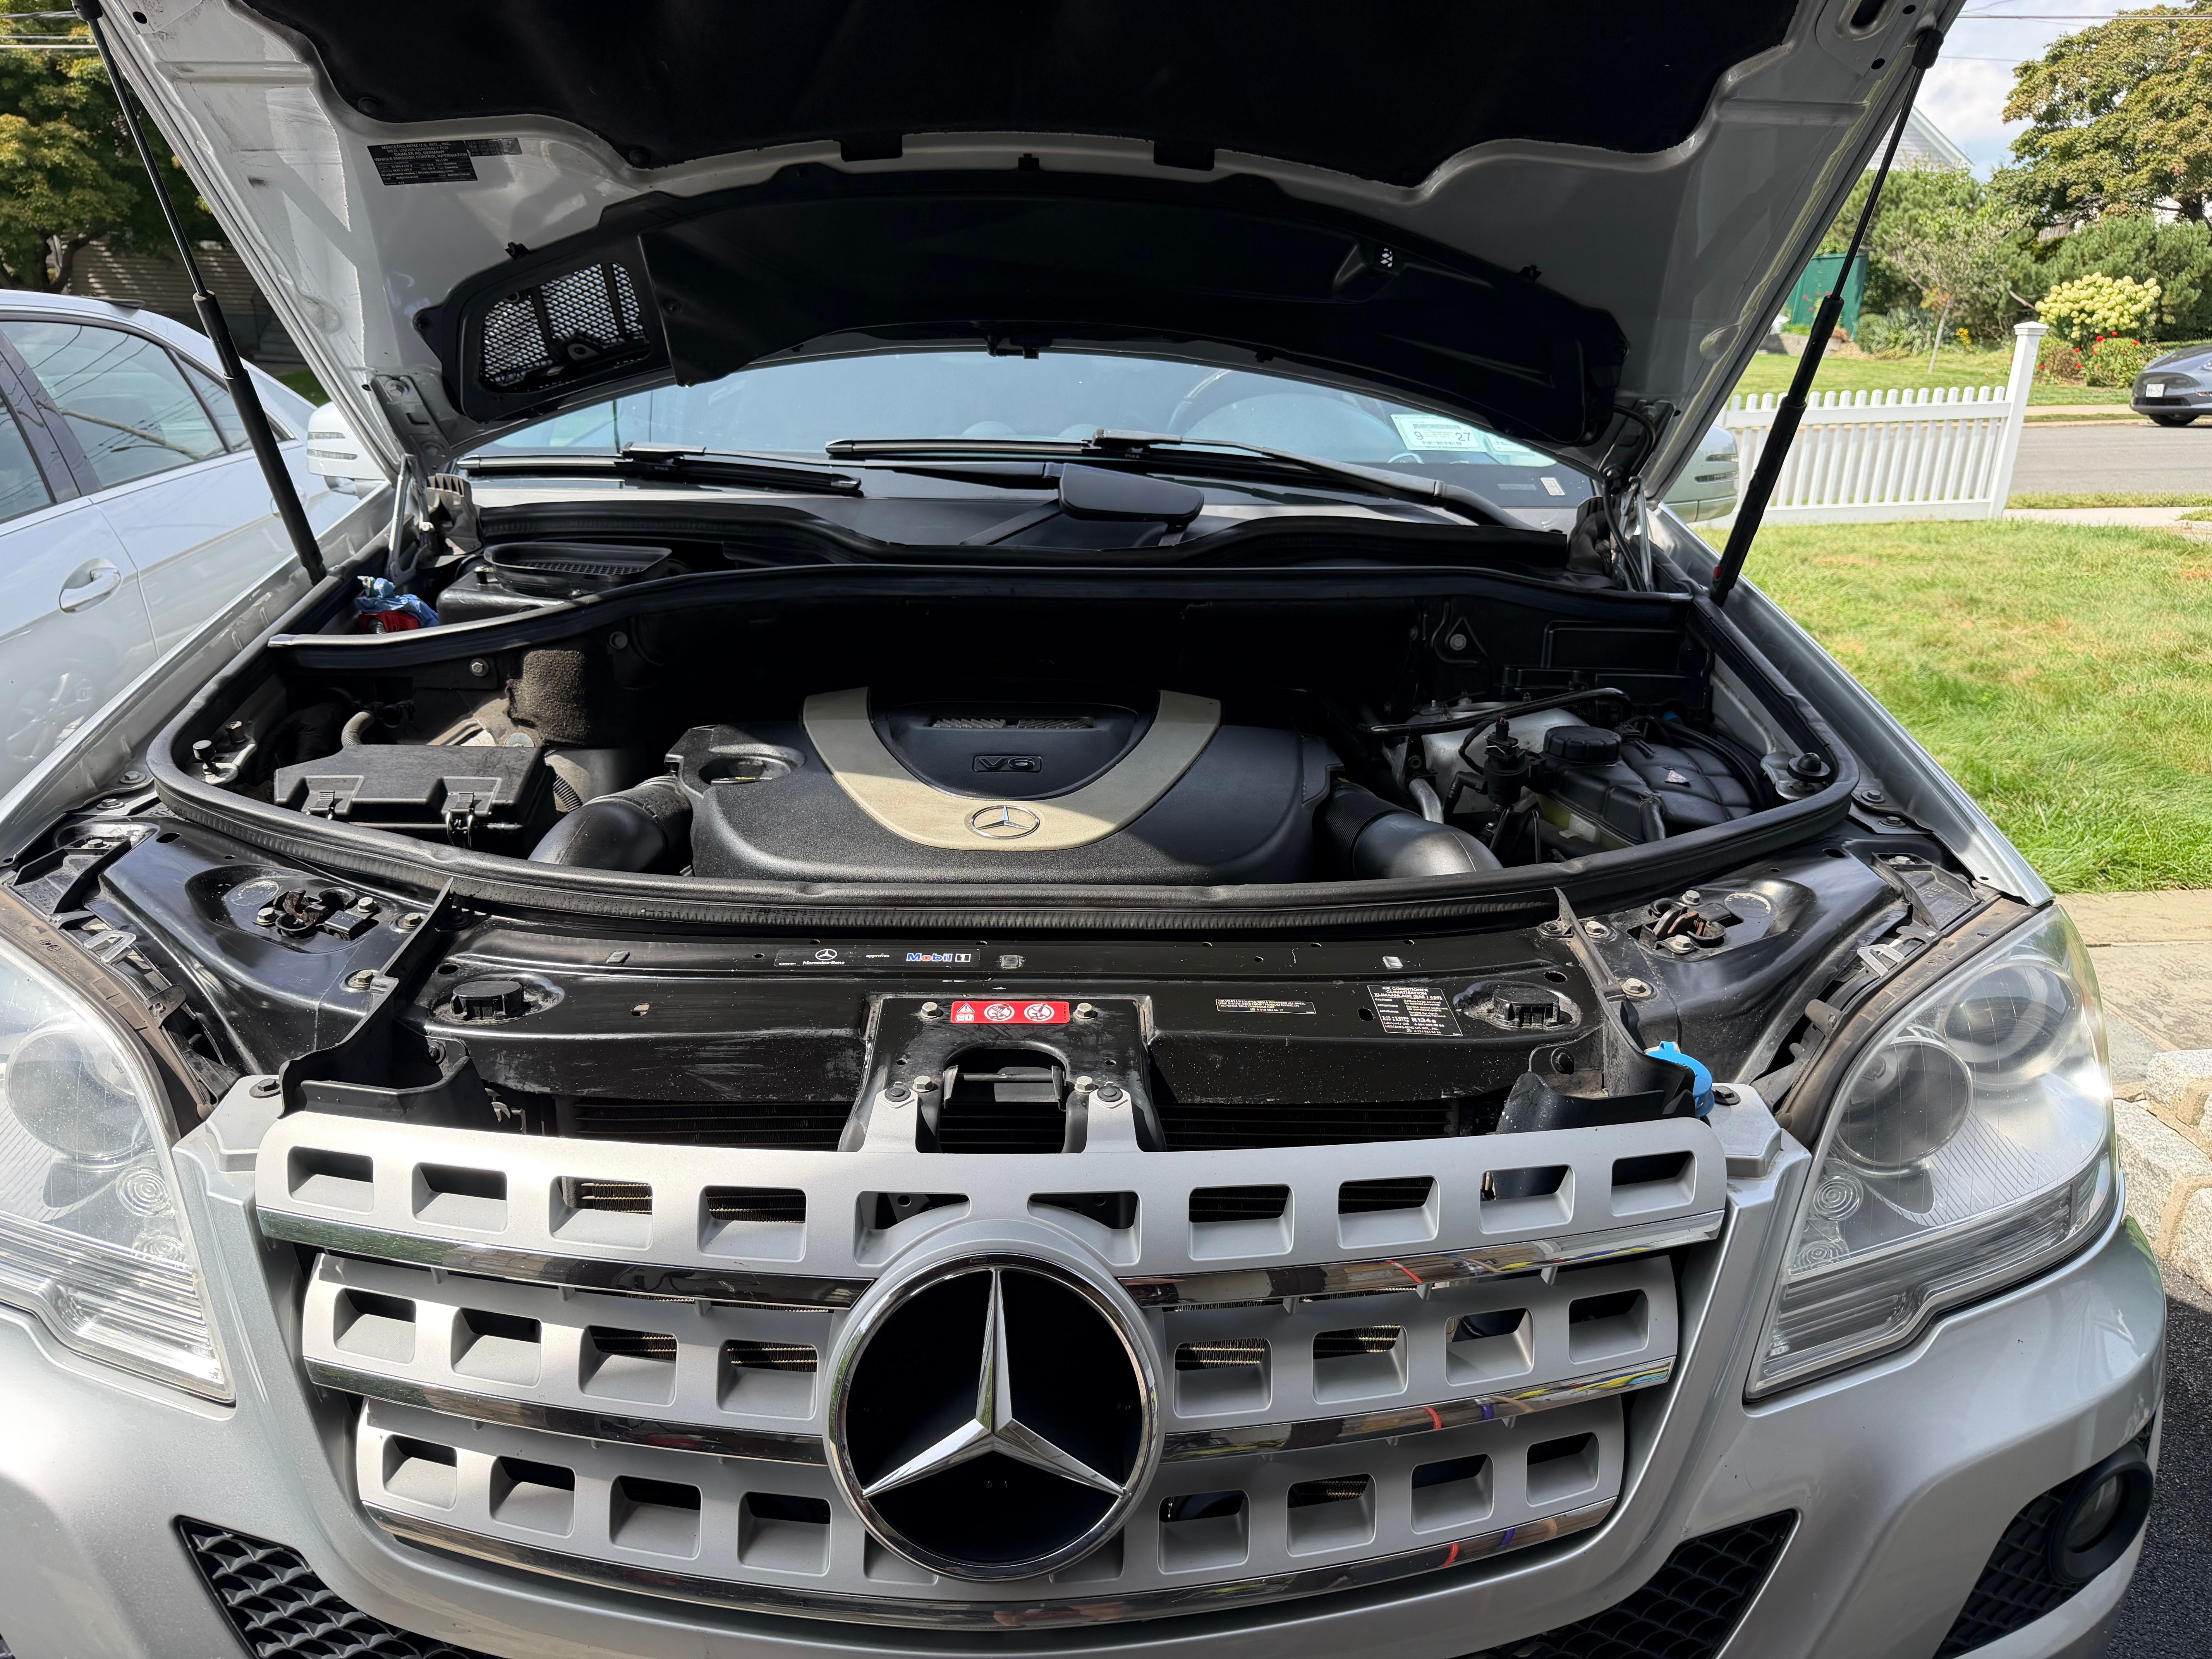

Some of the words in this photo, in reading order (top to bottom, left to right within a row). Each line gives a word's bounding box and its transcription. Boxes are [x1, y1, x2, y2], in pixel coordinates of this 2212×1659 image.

[1414, 431, 1423, 440] 9
[1455, 433, 1470, 441] 27
[979, 757, 1035, 770] V6
[906, 953, 953, 962] Mobil
